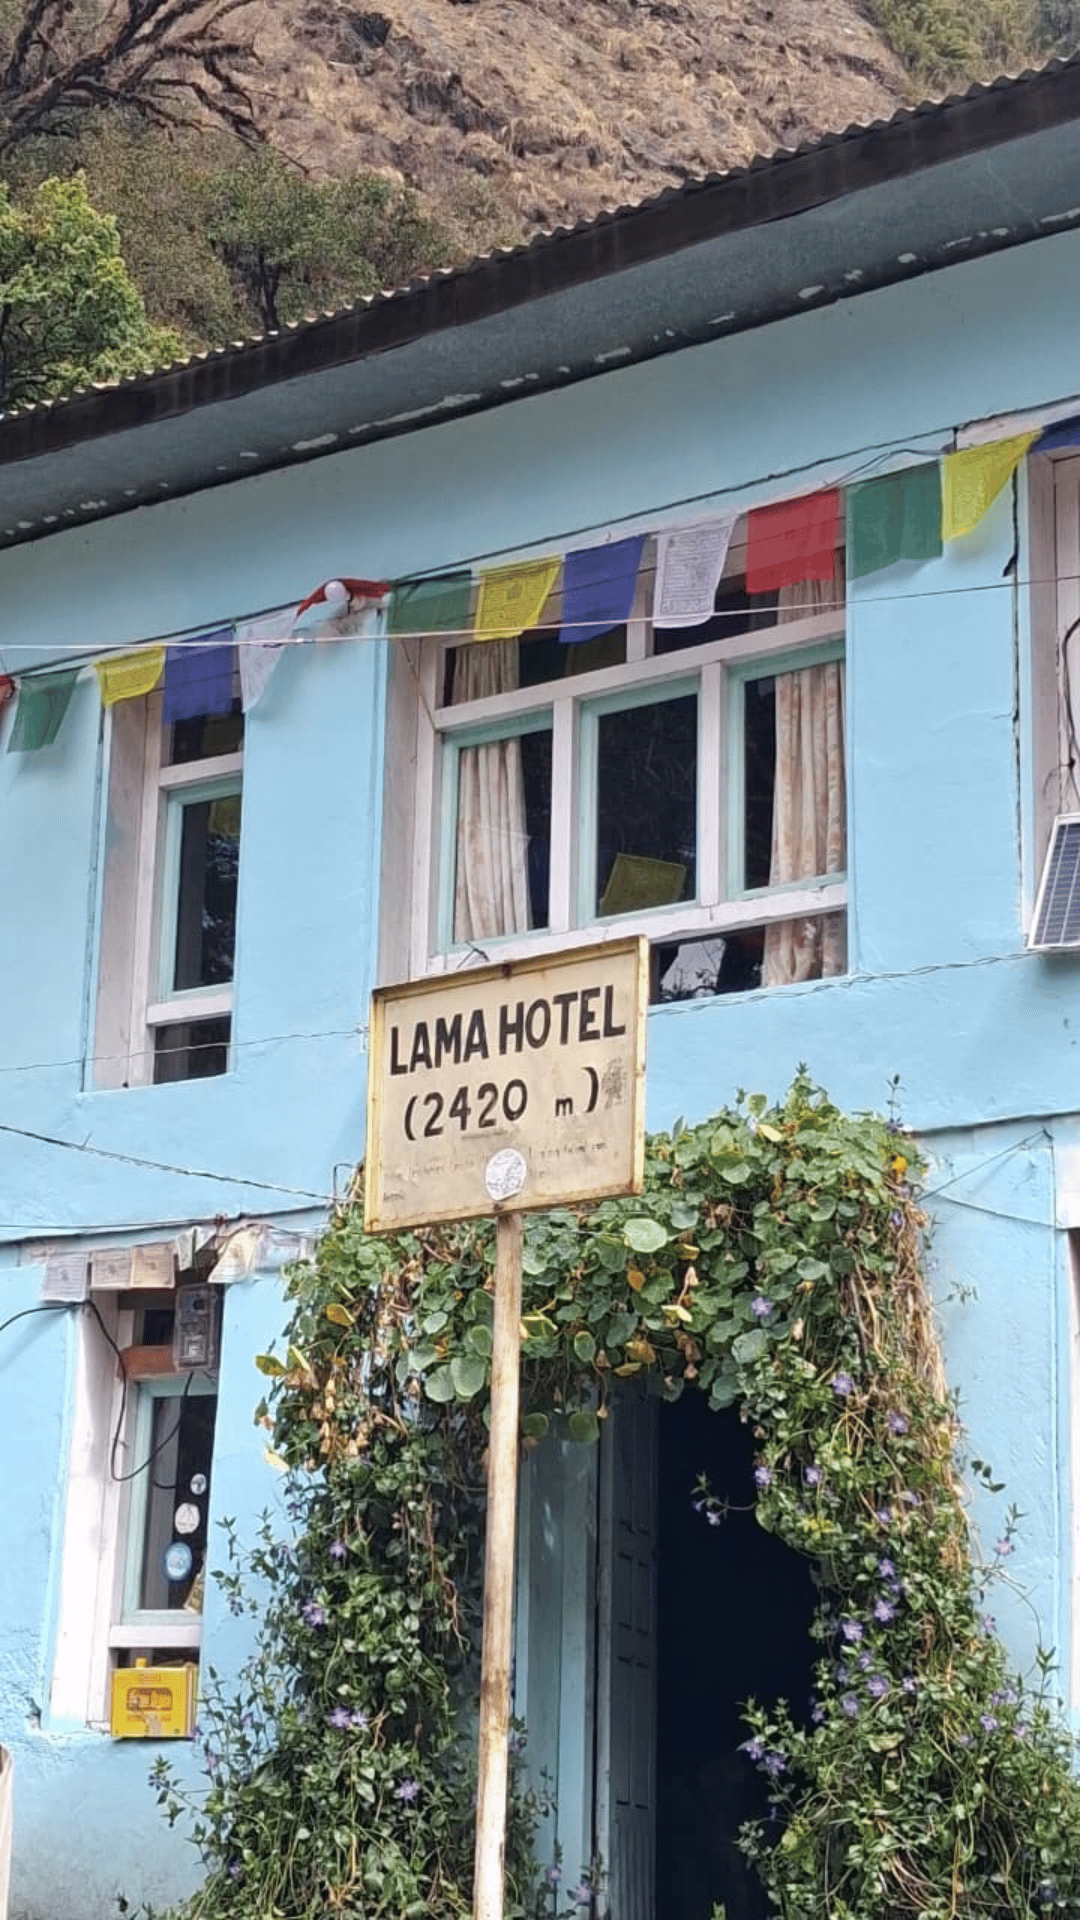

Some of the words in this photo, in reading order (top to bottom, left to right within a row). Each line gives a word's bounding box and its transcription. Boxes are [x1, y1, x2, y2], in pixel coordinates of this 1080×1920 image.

[391, 1009, 489, 1075] LAMA
[500, 985, 626, 1055] HOTEL
[404, 1079, 528, 1140] (2420
